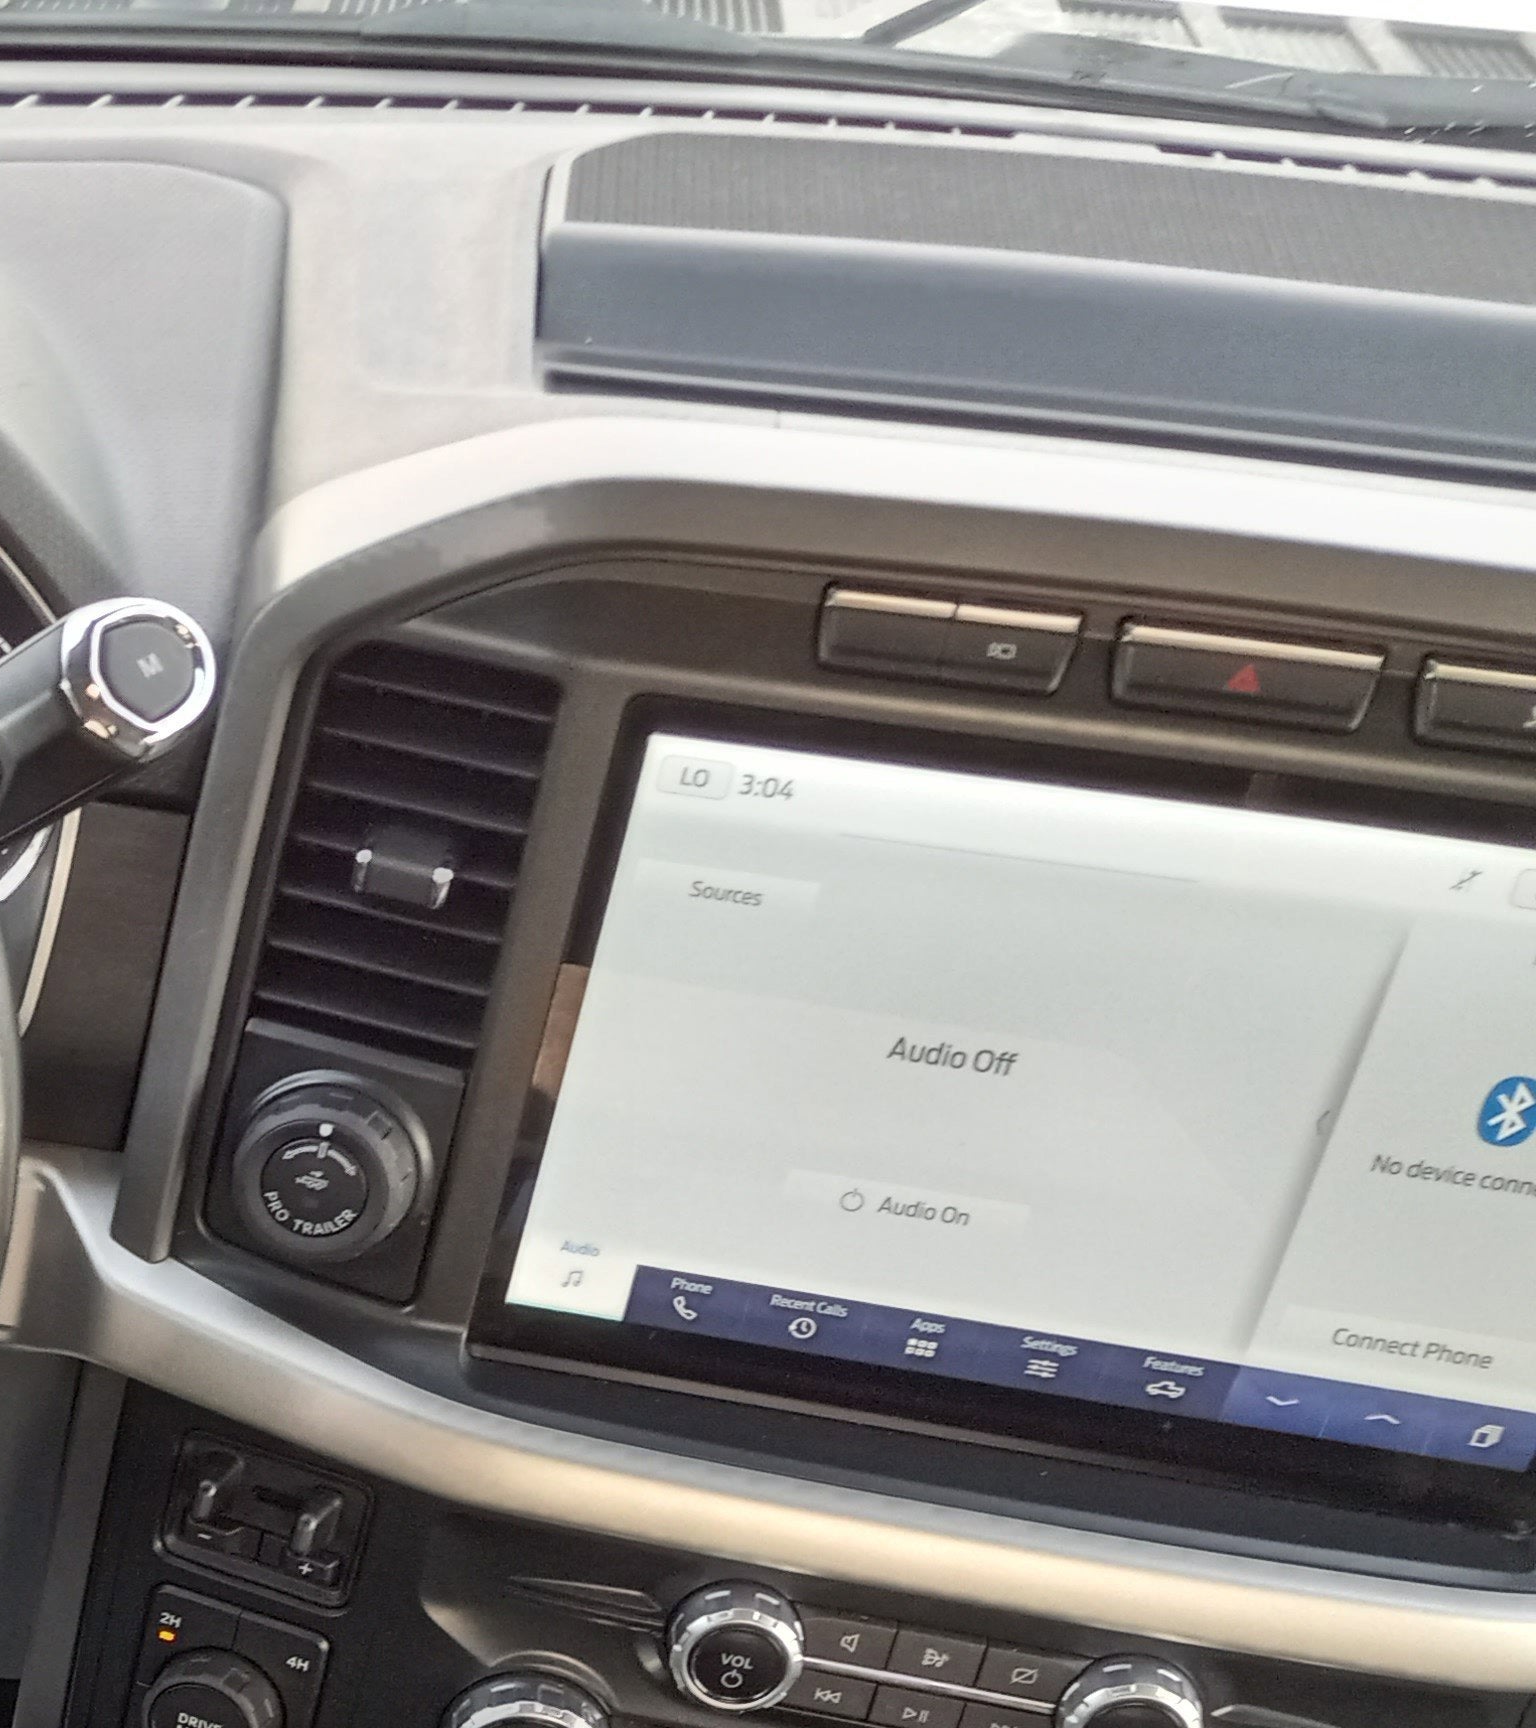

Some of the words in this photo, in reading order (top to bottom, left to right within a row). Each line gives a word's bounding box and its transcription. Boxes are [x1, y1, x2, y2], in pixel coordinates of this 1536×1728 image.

[678, 765, 710, 788] LO
[736, 774, 795, 801] 3:04
[688, 879, 763, 907] Sources
[885, 1036, 967, 1070] Audio
[972, 1048, 1018, 1077] Off
[1370, 1153, 1404, 1177] No
[1405, 1160, 1476, 1188] device
[263, 1189, 290, 1223] PRO
[292, 1207, 359, 1238] TRAILER
[877, 1196, 937, 1222] Audio
[940, 1205, 971, 1226] On
[560, 1239, 600, 1258] Audio
[671, 1277, 714, 1295] Phone
[770, 1294, 816, 1313] Recent
[816, 1299, 849, 1319] Calls
[910, 1316, 946, 1336] Apps
[1021, 1335, 1078, 1357] Settings
[1331, 1328, 1419, 1357] Connect
[1423, 1342, 1493, 1369] Phone
[1143, 1356, 1204, 1377] Features
[159, 1611, 182, 1628] 2H
[286, 1655, 310, 1672] 4H
[720, 1653, 754, 1671] VOL
